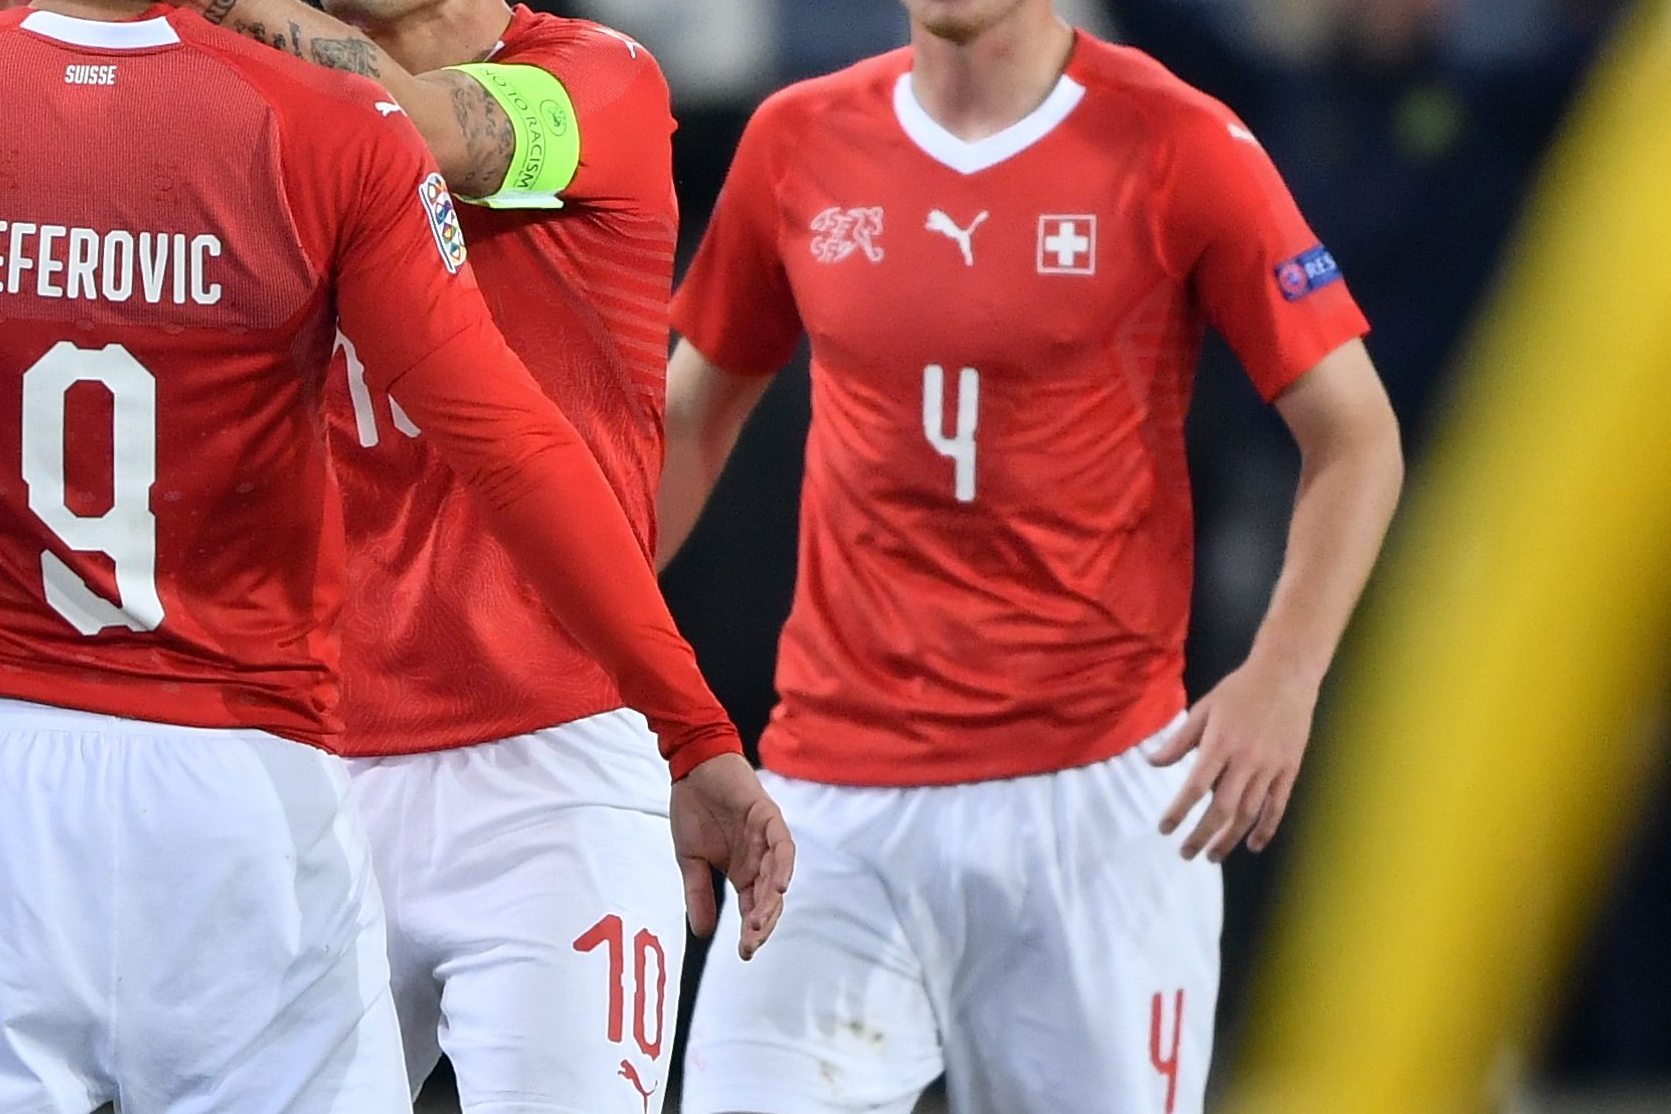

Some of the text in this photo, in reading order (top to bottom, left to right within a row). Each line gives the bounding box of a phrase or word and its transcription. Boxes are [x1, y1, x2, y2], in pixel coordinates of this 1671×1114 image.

[63, 64, 118, 85] SUISSE
[517, 115, 543, 189] RACISM
[21, 340, 166, 636] 9
[923, 363, 979, 502] 4
[572, 913, 666, 1062] 10
[1149, 988, 1185, 1114] 4
